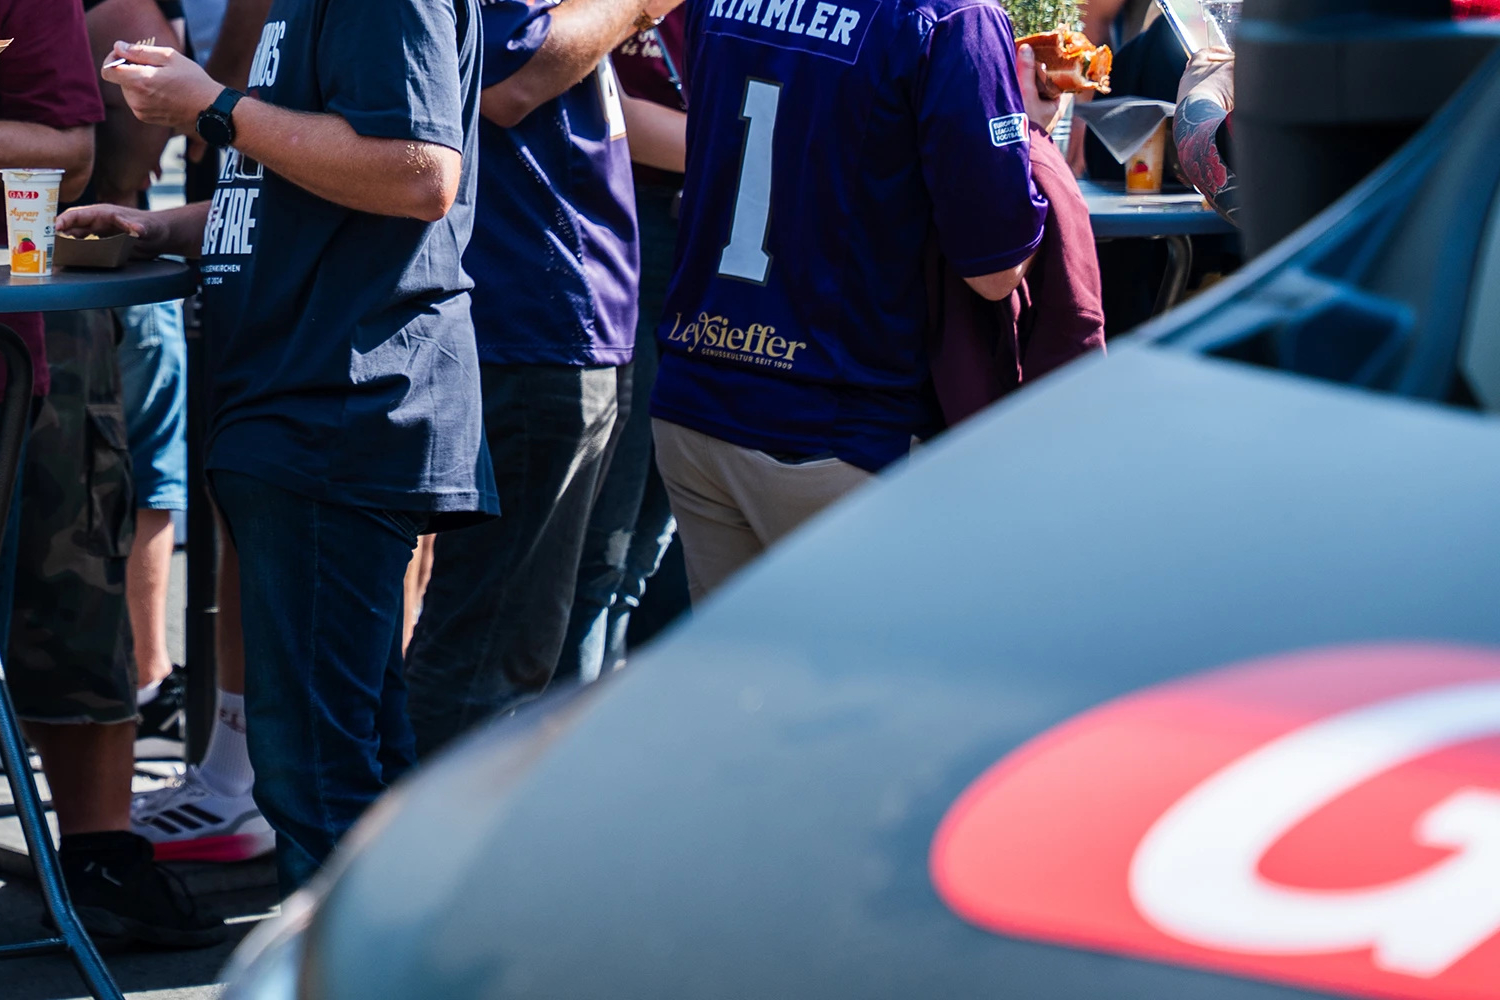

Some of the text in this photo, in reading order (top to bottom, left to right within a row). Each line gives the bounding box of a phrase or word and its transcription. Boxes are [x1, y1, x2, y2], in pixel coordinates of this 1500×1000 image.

[9, 190, 37, 200] GAZI
[717, 75, 783, 286] 1
[667, 311, 807, 361] Leysieffer
[701, 347, 793, 370] GENUSSKULTUR SEIT 1909
